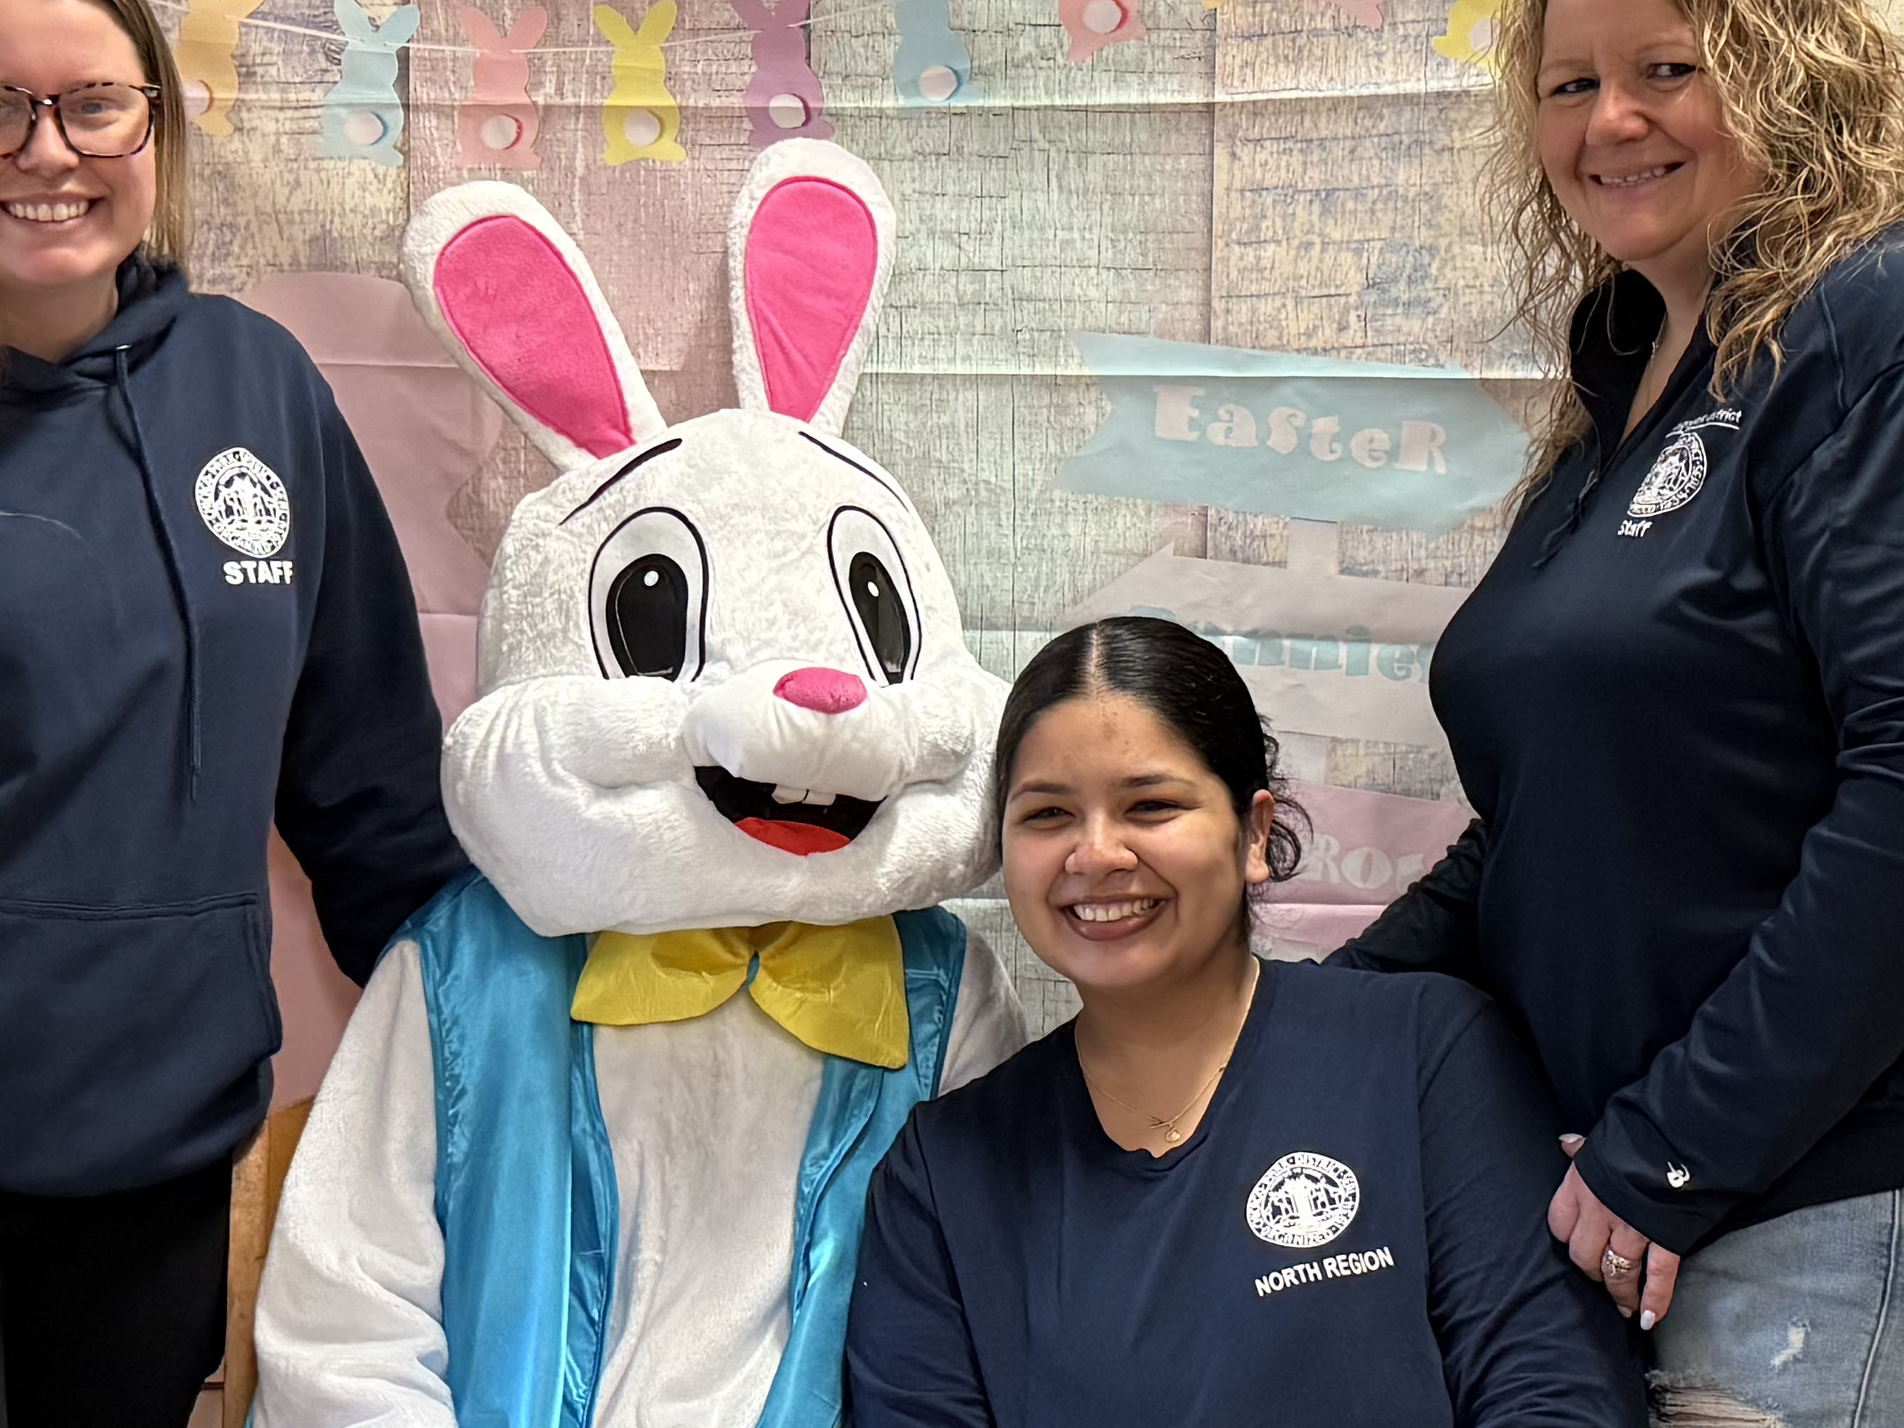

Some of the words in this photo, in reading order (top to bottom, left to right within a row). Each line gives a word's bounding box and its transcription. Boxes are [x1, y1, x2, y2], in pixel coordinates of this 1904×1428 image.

[223, 559, 294, 585] STAFF
[1254, 1261, 1323, 1297] NORTH
[1322, 1246, 1395, 1279] REGION
